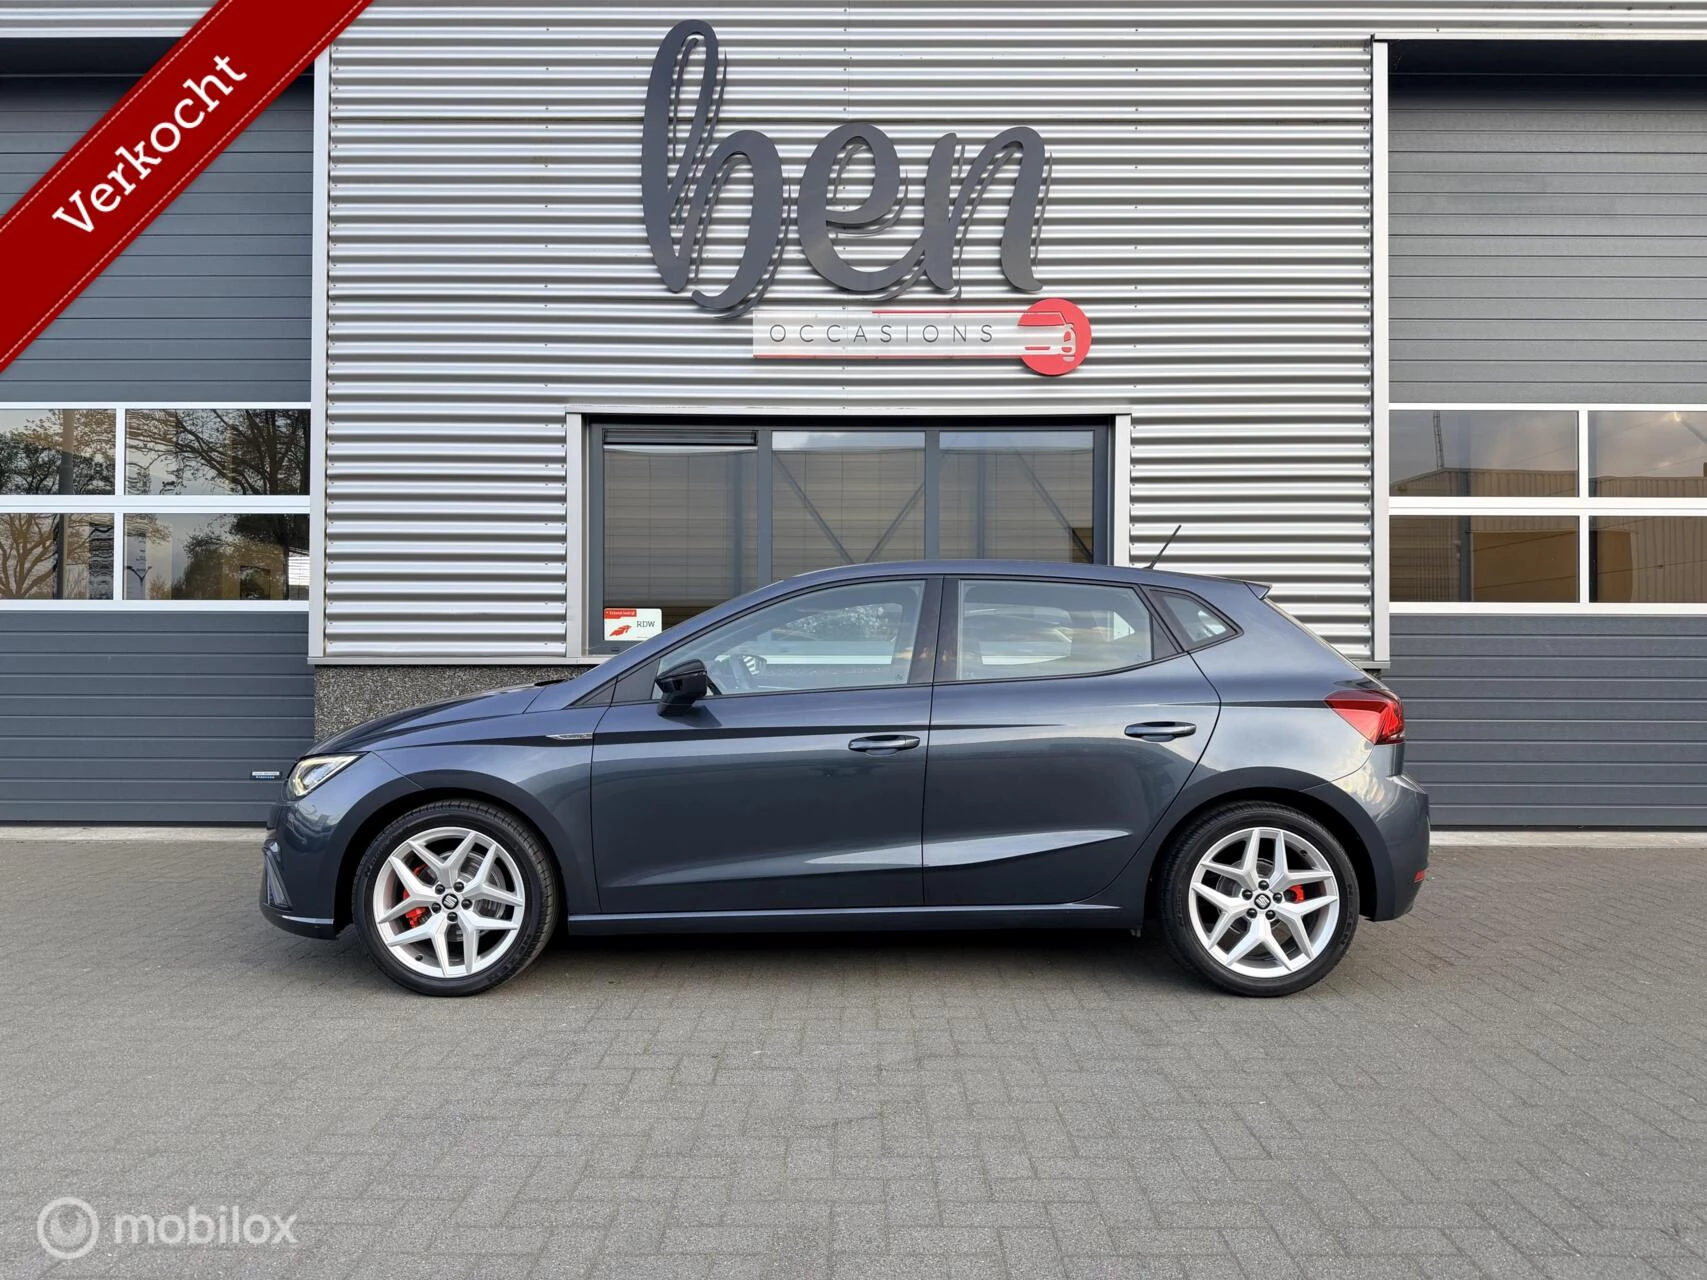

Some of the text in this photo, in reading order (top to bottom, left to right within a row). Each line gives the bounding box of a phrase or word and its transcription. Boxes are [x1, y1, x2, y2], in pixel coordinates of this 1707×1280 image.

[641, 19, 1043, 310] ben
[769, 324, 993, 343] OCCASIONS
[636, 620, 656, 628] RDW
